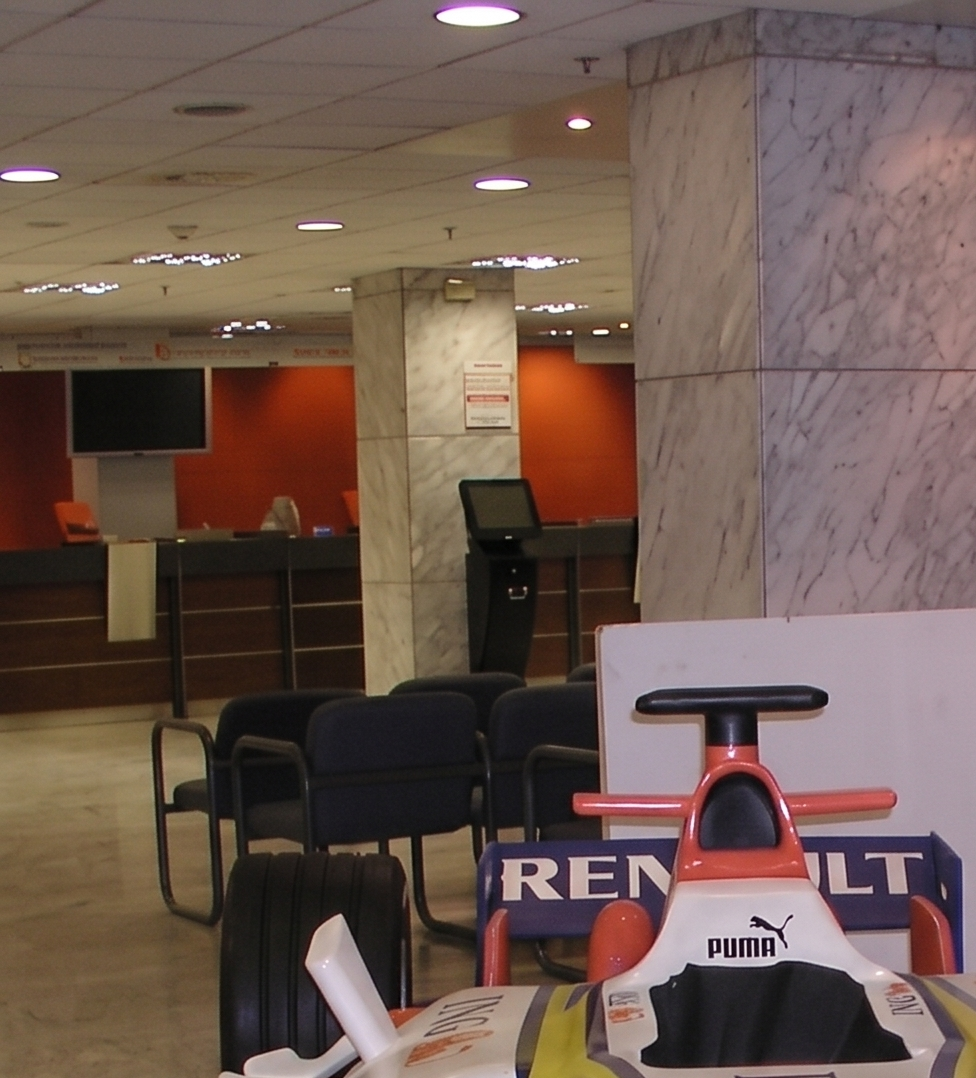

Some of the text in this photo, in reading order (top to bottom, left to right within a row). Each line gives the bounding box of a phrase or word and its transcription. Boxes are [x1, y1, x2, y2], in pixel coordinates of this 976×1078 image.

[707, 937, 776, 958] PUMA
[886, 995, 924, 1015] ING
[423, 995, 504, 1037] ING
